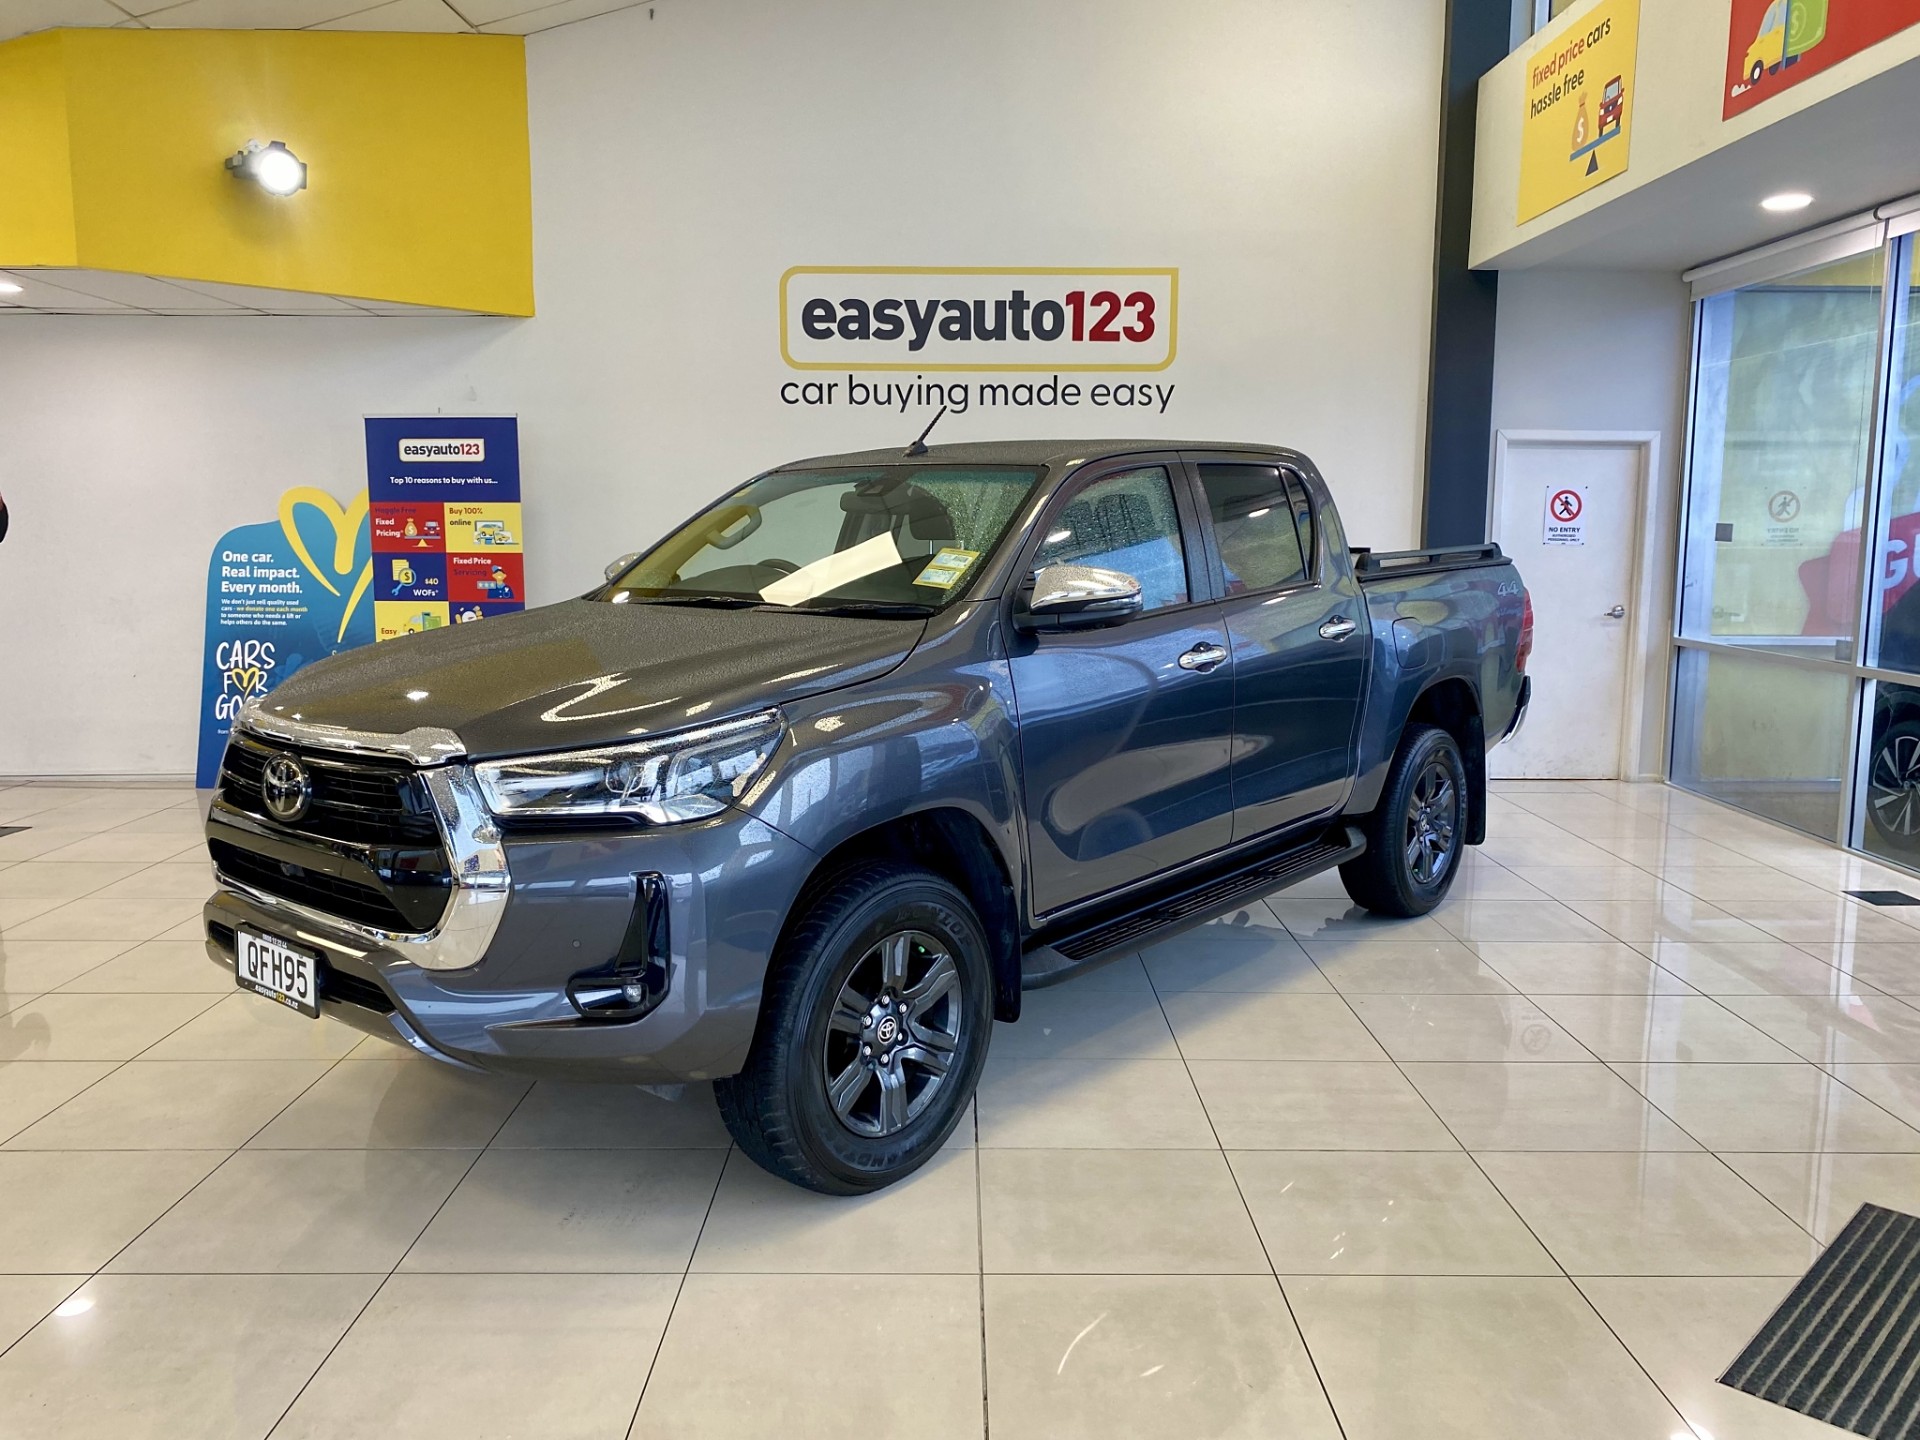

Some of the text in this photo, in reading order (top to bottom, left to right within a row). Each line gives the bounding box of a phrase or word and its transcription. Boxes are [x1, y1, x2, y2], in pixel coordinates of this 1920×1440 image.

[1532, 17, 1611, 89] fixed price cars
[1530, 69, 1585, 119] hassle free
[801, 290, 1156, 351] easyauto123
[780, 374, 1175, 414] car buying made easy
[404, 443, 480, 457] easyauto123
[390, 476, 404, 486] Top
[405, 476, 413, 484] 10
[452, 476, 465, 486] buy
[222, 550, 274, 562] One car.
[222, 566, 300, 580] Real impact.
[454, 569, 487, 577] Servicing
[221, 581, 302, 595] Every month.
[216, 640, 275, 669] CARS
[248, 941, 308, 998] QFH95
[255, 984, 298, 1009] easyauto123.co.nz
